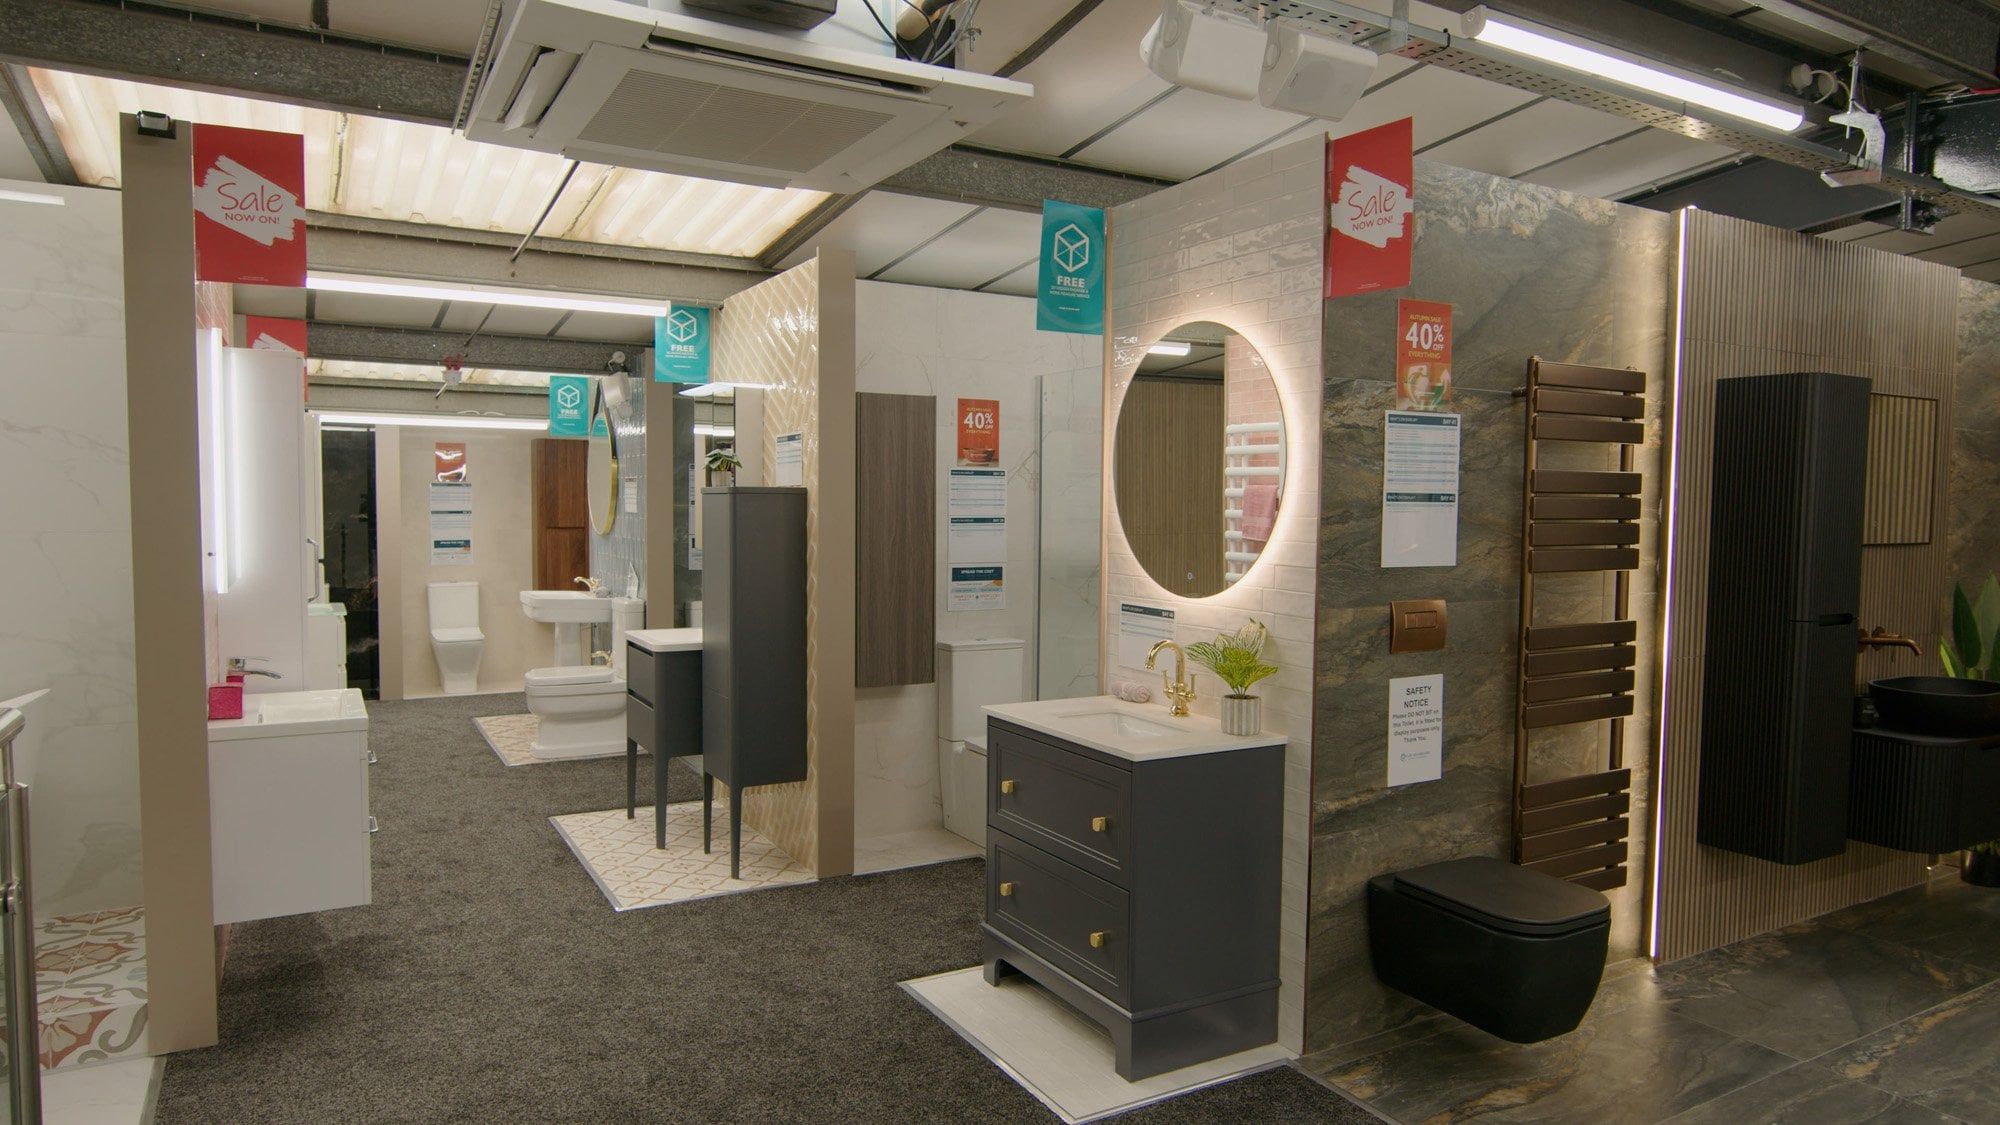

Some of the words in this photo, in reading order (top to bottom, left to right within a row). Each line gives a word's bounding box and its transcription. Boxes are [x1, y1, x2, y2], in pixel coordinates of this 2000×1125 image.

[217, 182, 284, 213] Sale
[1347, 185, 1396, 221] Sale
[225, 212, 256, 222] NOW
[258, 215, 281, 224] ON!
[1352, 217, 1375, 231] NOW
[1377, 215, 1393, 226] ON!
[1057, 276, 1085, 288] FREE
[1405, 322, 1445, 350] 40%
[671, 344, 695, 352] FREE
[1432, 343, 1445, 351] OFF
[1408, 351, 1441, 359] EVERYTHING
[963, 412, 994, 429] 40%
[1406, 685, 1432, 696] SAFETY
[1403, 698, 1429, 709] NOTICE
[1410, 727, 1430, 735] purposes
